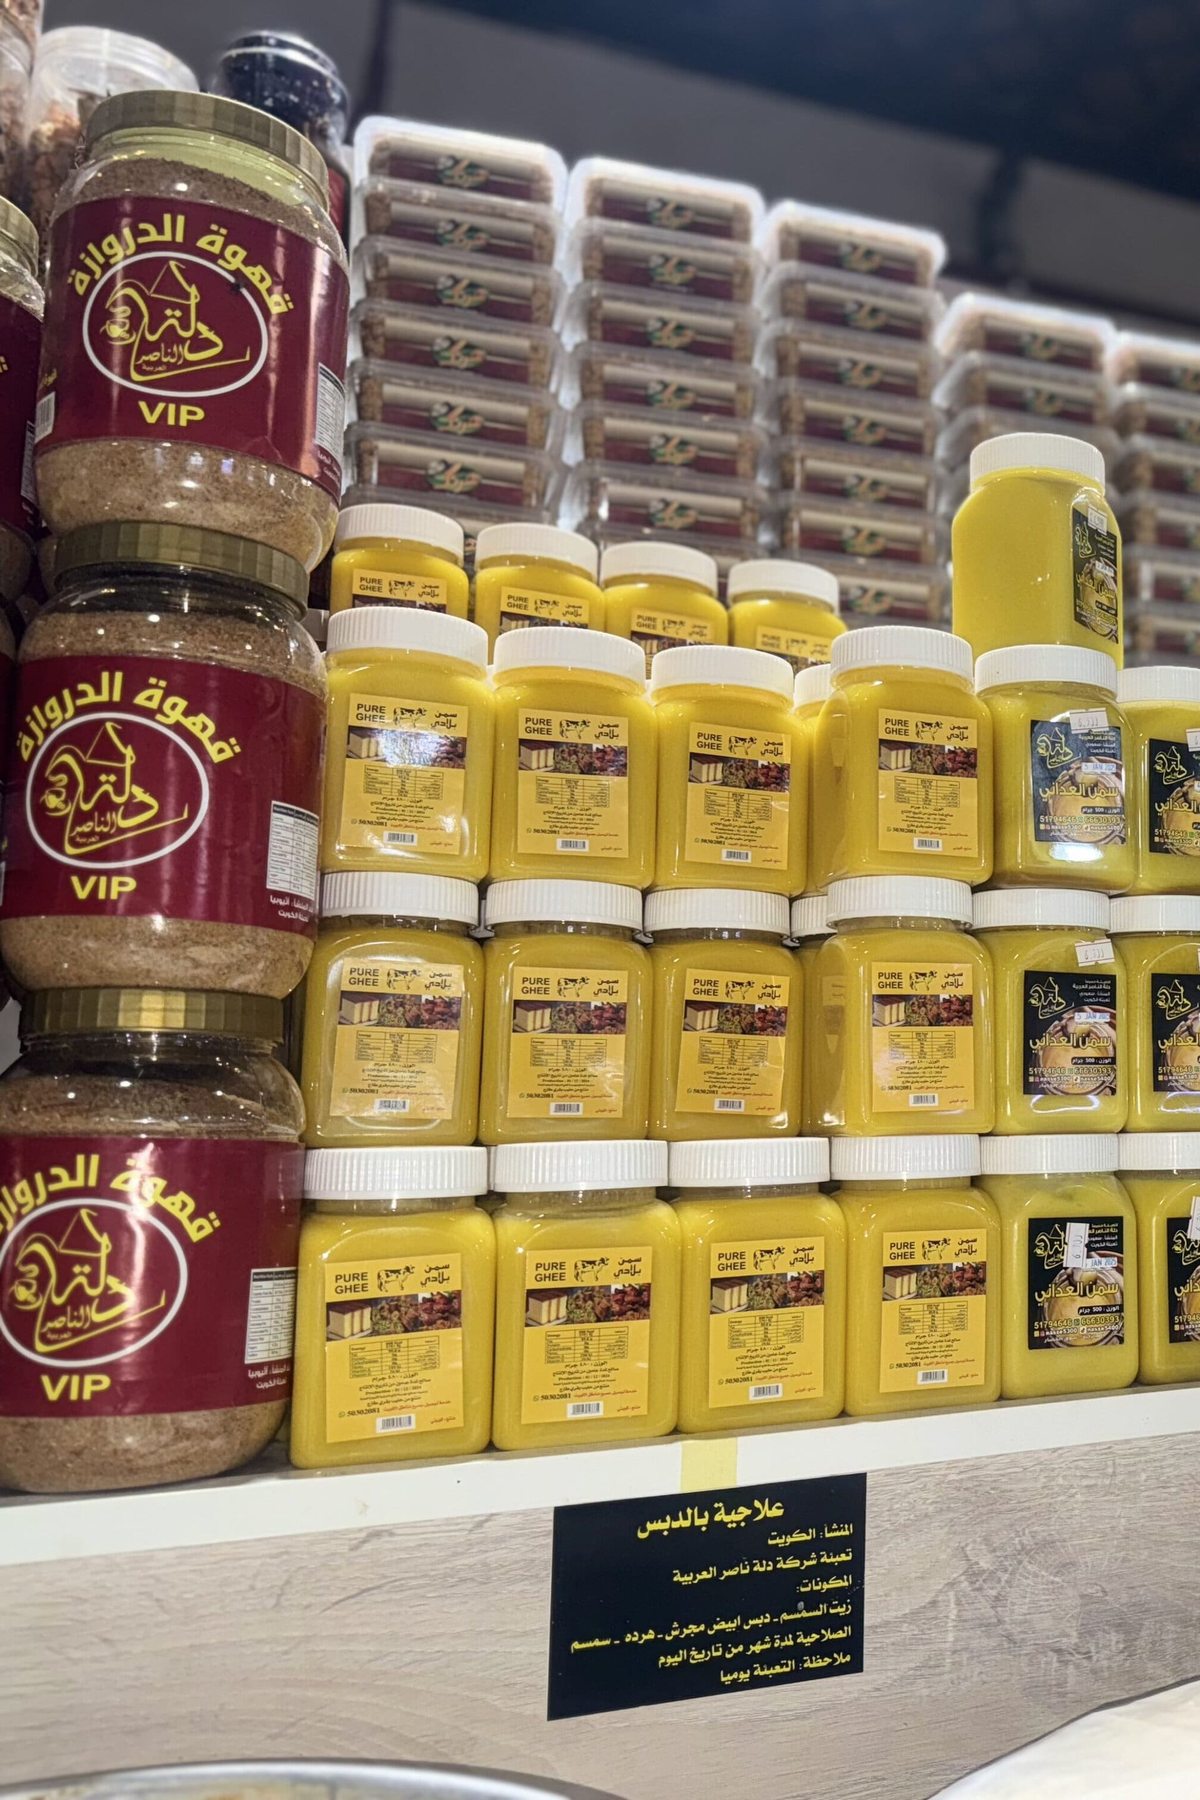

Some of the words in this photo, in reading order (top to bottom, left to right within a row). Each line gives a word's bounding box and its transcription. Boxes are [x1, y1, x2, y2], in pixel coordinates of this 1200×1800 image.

[67, 214, 185, 296] الدروازة
[196, 223, 294, 315] قهوة
[136, 343, 184, 365] الناصر
[138, 401, 205, 426] VIP
[360, 576, 383, 585] PURE
[359, 584, 383, 593] GHEE
[507, 594, 529, 603] PURE
[507, 602, 529, 611] GHEE
[357, 703, 386, 714] PURE
[434, 710, 457, 718] سمن
[16, 672, 122, 762] الدروازة
[133, 677, 241, 763] قهوة
[356, 712, 385, 723] GHEE
[525, 717, 552, 726] PURE
[431, 719, 457, 729] بلادي
[885, 718, 909, 728] PURE
[525, 726, 552, 736] GHEE
[595, 729, 619, 740] بلادي
[885, 727, 909, 736] GHEE
[947, 731, 968, 741] بلادي
[697, 732, 722, 742] PURE
[764, 738, 783, 746] سمن
[697, 741, 722, 750] GHEE
[761, 747, 783, 756] بلادي
[1088, 786, 1119, 799] سمن
[70, 812, 118, 837] الناصر
[70, 876, 137, 900] VIP
[350, 968, 379, 976] PURE
[878, 972, 903, 980] PURE
[349, 977, 379, 986] GHEE
[425, 979, 451, 991] بلادي
[522, 977, 550, 985] PURE
[694, 979, 719, 988] PURE
[878, 981, 903, 989] GHEE
[941, 979, 963, 990] بلادي
[522, 987, 550, 995] GHEE
[593, 986, 618, 996] بلادي
[693, 987, 719, 997] GHEE
[758, 990, 780, 1000] بلادي
[1079, 1035, 1111, 1049] سمن
[110, 1157, 220, 1243] قهوة
[890, 1241, 915, 1250] PURE
[958, 1237, 977, 1245] سمن
[793, 1245, 814, 1255] سمن
[890, 1251, 915, 1260] GHEE
[955, 1245, 977, 1257] بلادي
[618, 1256, 642, 1265] سمن
[718, 1251, 746, 1261] PURE
[790, 1253, 814, 1267] بلادي
[424, 1263, 450, 1273] سمن
[536, 1262, 566, 1272] PURE
[614, 1264, 641, 1279] بلادي
[718, 1261, 746, 1271] GHEE
[335, 1272, 368, 1283] PURE
[420, 1272, 450, 1288] بلادي
[535, 1272, 566, 1282] GHEE
[335, 1284, 368, 1294] GHEE
[1086, 1281, 1119, 1298] سمن
[42, 1306, 92, 1332] الناصر
[41, 1375, 111, 1401] VIP
[714, 1498, 784, 1528] علاجية
[638, 1506, 709, 1538] بالدبس
[768, 1528, 816, 1547] الكويت
[776, 1552, 817, 1569] شركة
[820, 1548, 852, 1565] تعبئة
[719, 1562, 750, 1580] ناصر
[753, 1560, 773, 1571] دلة
[673, 1566, 716, 1585] العربية
[797, 1575, 852, 1592] المكونات:
[780, 1602, 826, 1624] السمسم
[829, 1599, 851, 1616] زيت
[744, 1614, 770, 1629] دبس
[665, 1622, 705, 1640] مجرش
[796, 1626, 851, 1646] الصلاحية
[625, 1630, 655, 1644] هرده
[774, 1634, 794, 1648] لمدة
[571, 1638, 611, 1653] سمسم
[746, 1636, 771, 1654] شهر
[690, 1644, 722, 1663] تاريخ
[725, 1644, 743, 1658] من
[659, 1650, 686, 1668] اليوم
[800, 1652, 850, 1669] ملاحظة:
[754, 1660, 795, 1678] التعبئة
[721, 1670, 750, 1684] يوميا
